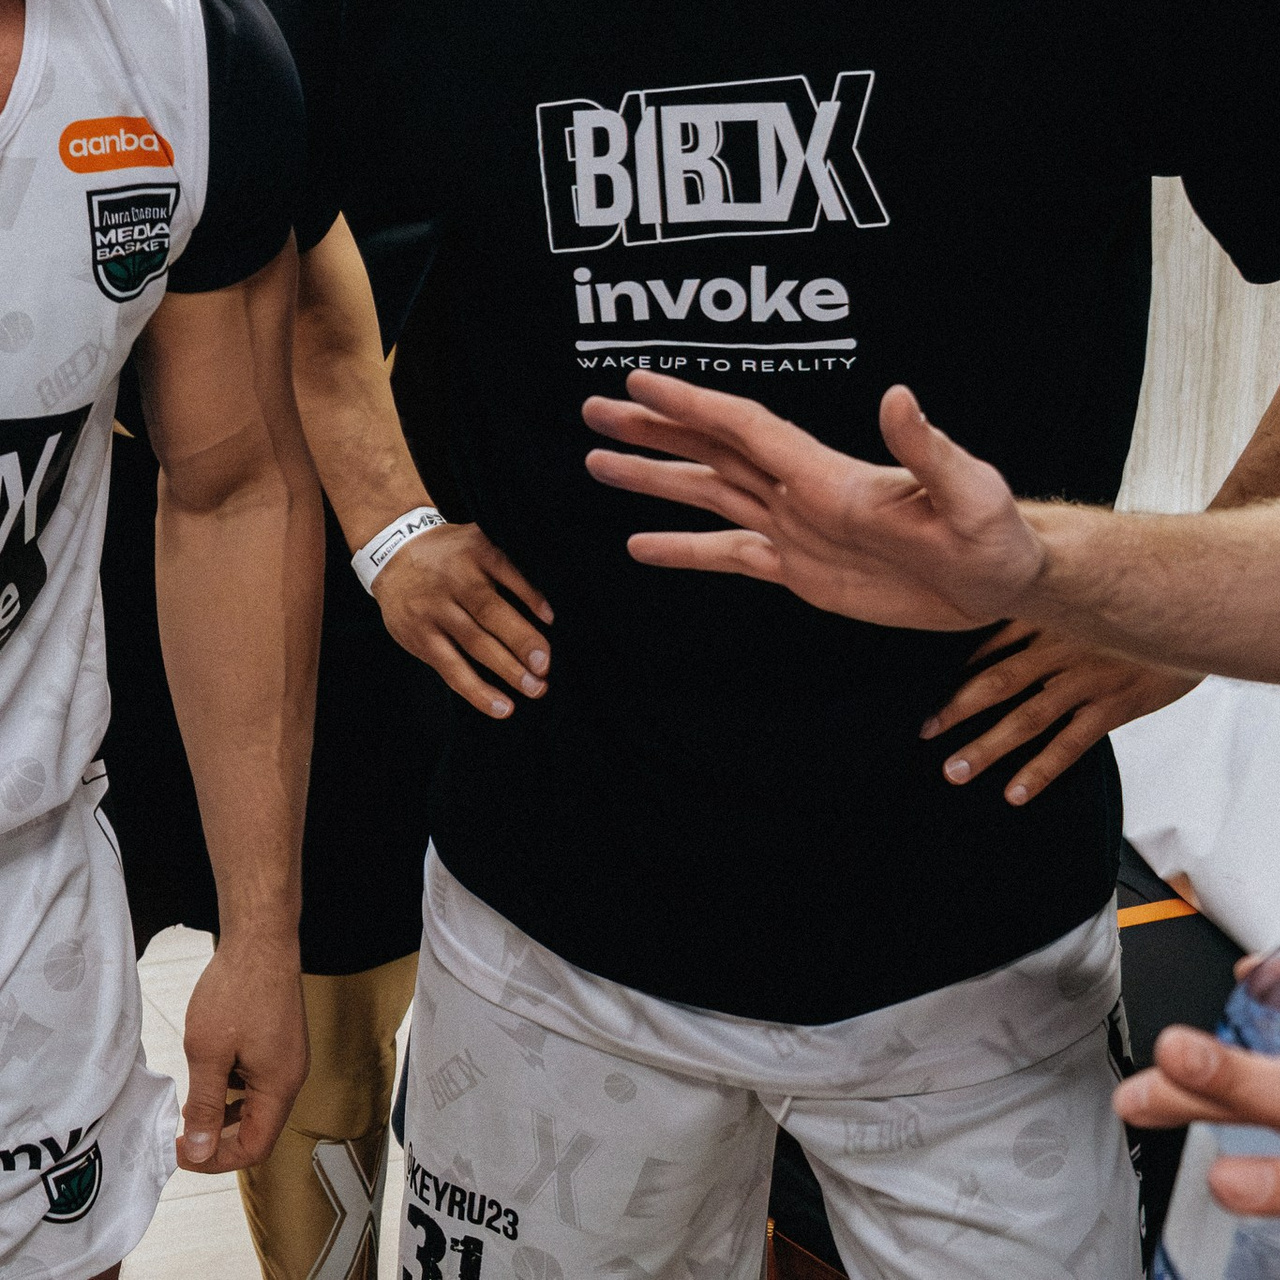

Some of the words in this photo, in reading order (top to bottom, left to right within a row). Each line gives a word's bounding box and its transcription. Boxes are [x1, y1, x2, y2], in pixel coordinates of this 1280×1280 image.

[69, 129, 159, 157] aanba
[536, 70, 889, 252] BIBOX
[95, 222, 170, 247] MEDIA
[97, 238, 169, 260] BASKET
[573, 265, 849, 324] invoke
[577, 356, 651, 369] WAKE
[660, 356, 687, 369] UP
[697, 358, 731, 371] TO
[742, 356, 856, 372] REALITY
